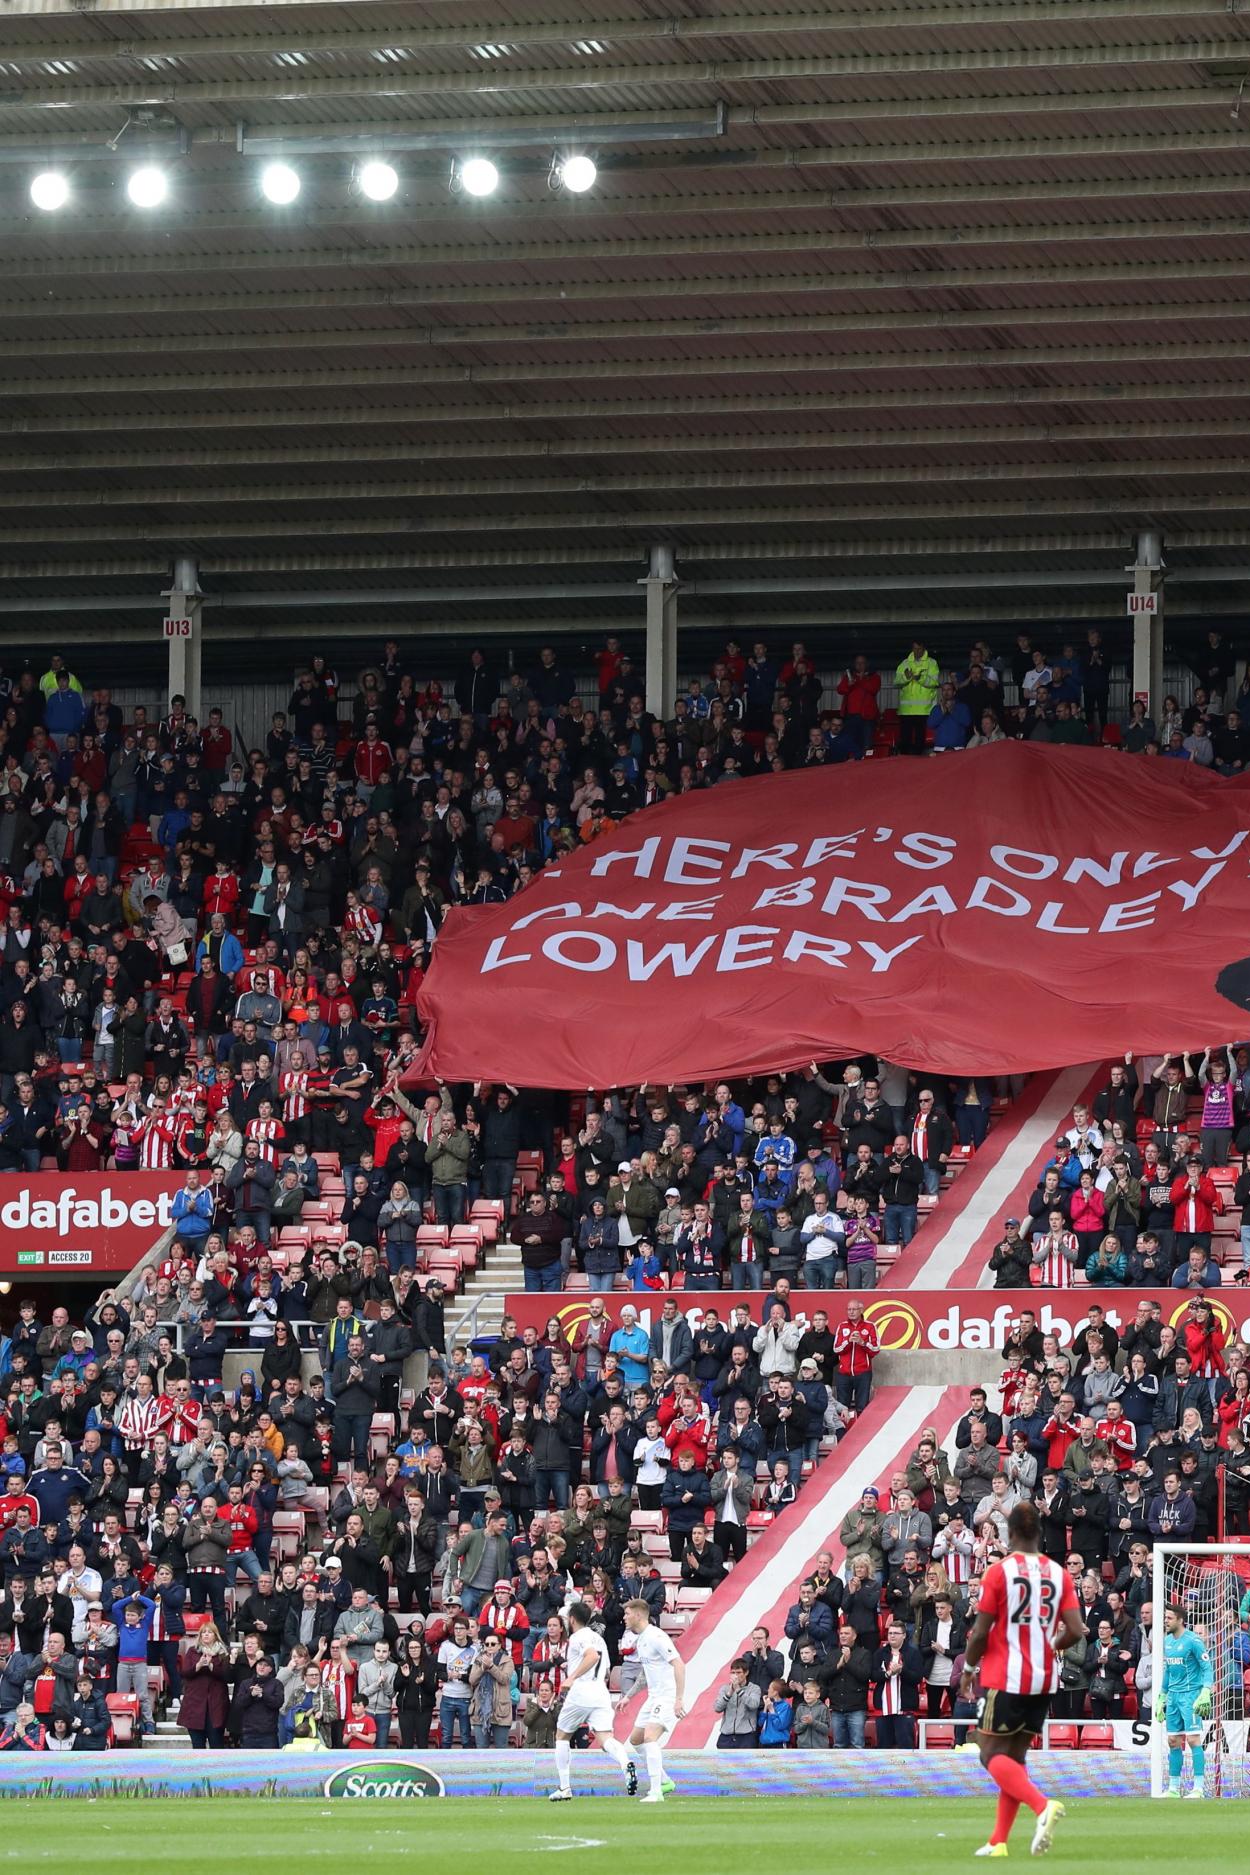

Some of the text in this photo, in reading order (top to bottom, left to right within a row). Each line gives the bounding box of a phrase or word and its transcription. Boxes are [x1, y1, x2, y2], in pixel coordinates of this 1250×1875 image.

[1130, 596, 1155, 611] U14
[165, 620, 190, 636] U13
[752, 860, 1228, 934] BRADLEY
[480, 924, 924, 982] LOWERY
[1, 1188, 174, 1237] dafabet
[18, 1254, 36, 1263] EXIT
[51, 1253, 90, 1262] ACCESS 20
[1158, 1509, 1181, 1520] JACK
[1011, 1577, 1056, 1625] 23
[343, 1774, 428, 1797] Scotts
